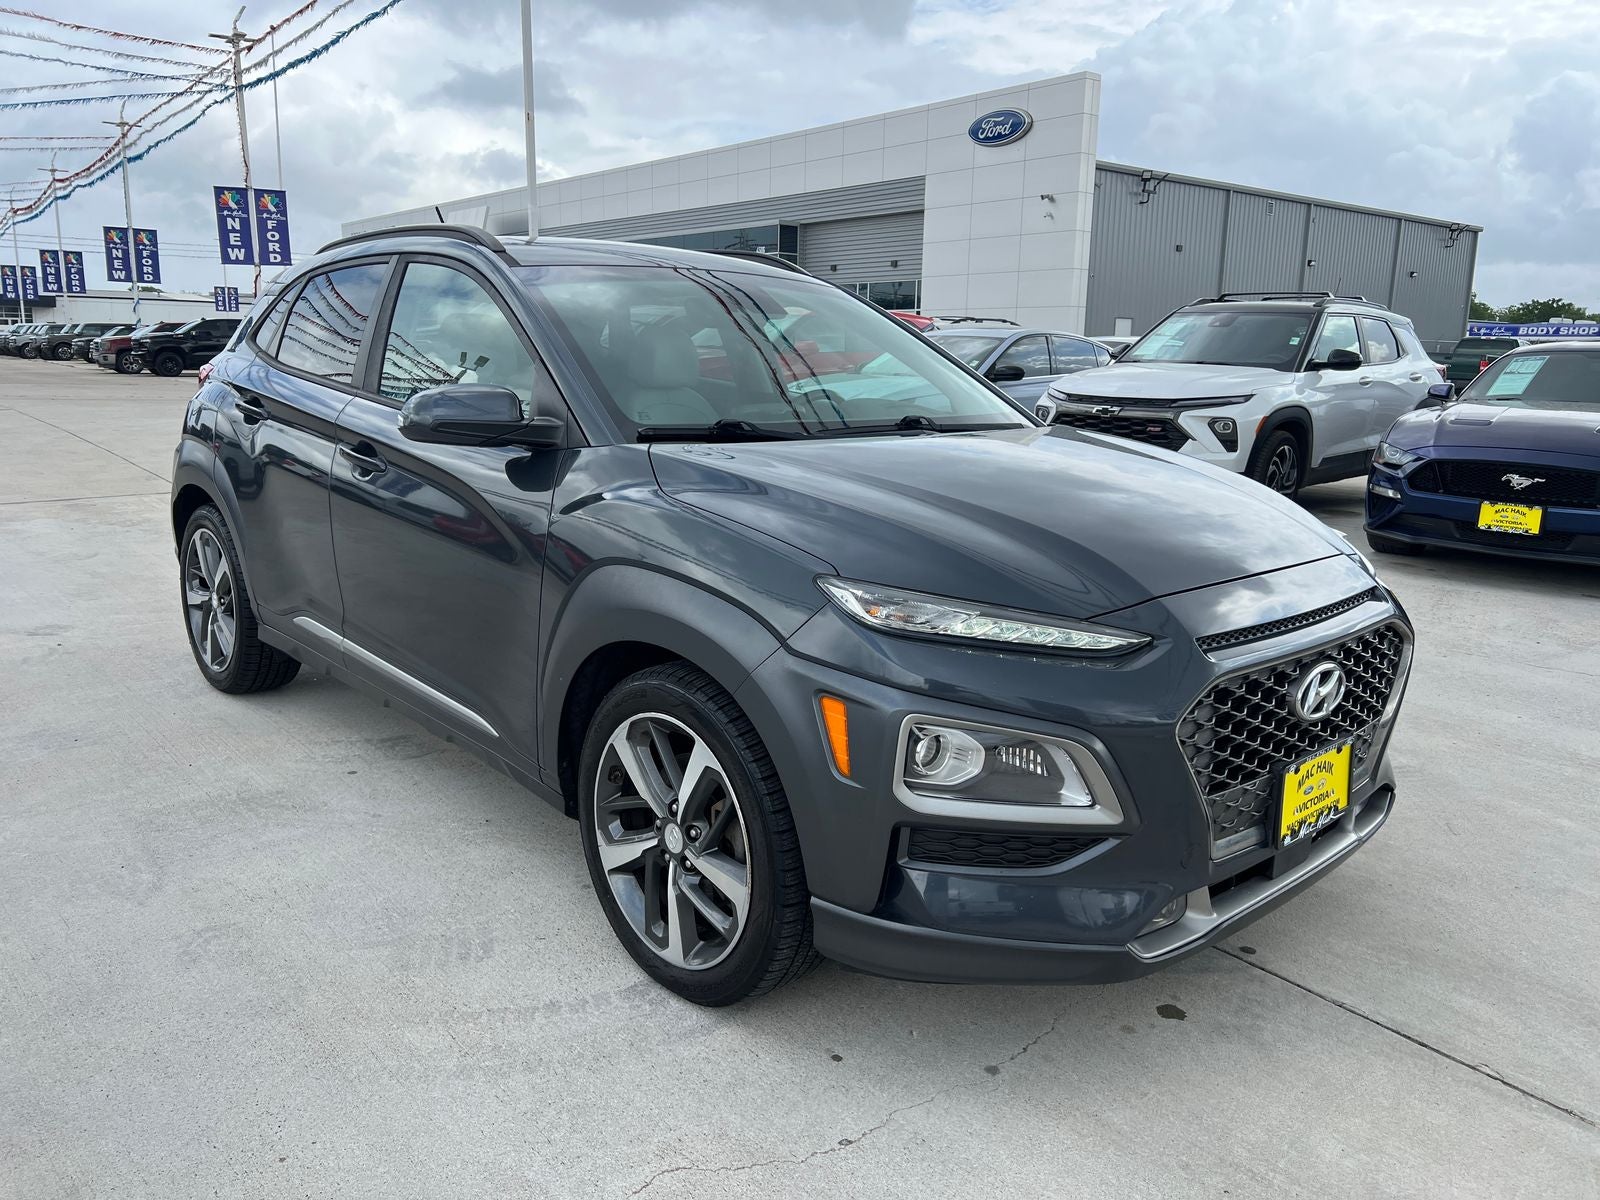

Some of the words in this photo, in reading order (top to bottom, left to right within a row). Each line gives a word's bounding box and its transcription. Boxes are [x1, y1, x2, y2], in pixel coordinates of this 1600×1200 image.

[978, 116, 1013, 139] Ford
[226, 217, 246, 261] NEW
[266, 220, 282, 263] FORD
[111, 248, 126, 280] NEW
[141, 250, 154, 281] FORD
[46, 266, 58, 291] NEW
[70, 267, 81, 292] FORD
[1518, 326, 1557, 335] BODY
[1559, 326, 1599, 335] SHOP
[1494, 507, 1509, 515] MAC
[1296, 763, 1316, 793] MAC
[1315, 759, 1335, 776] HAIK
[1297, 790, 1329, 814] VICTORIA
